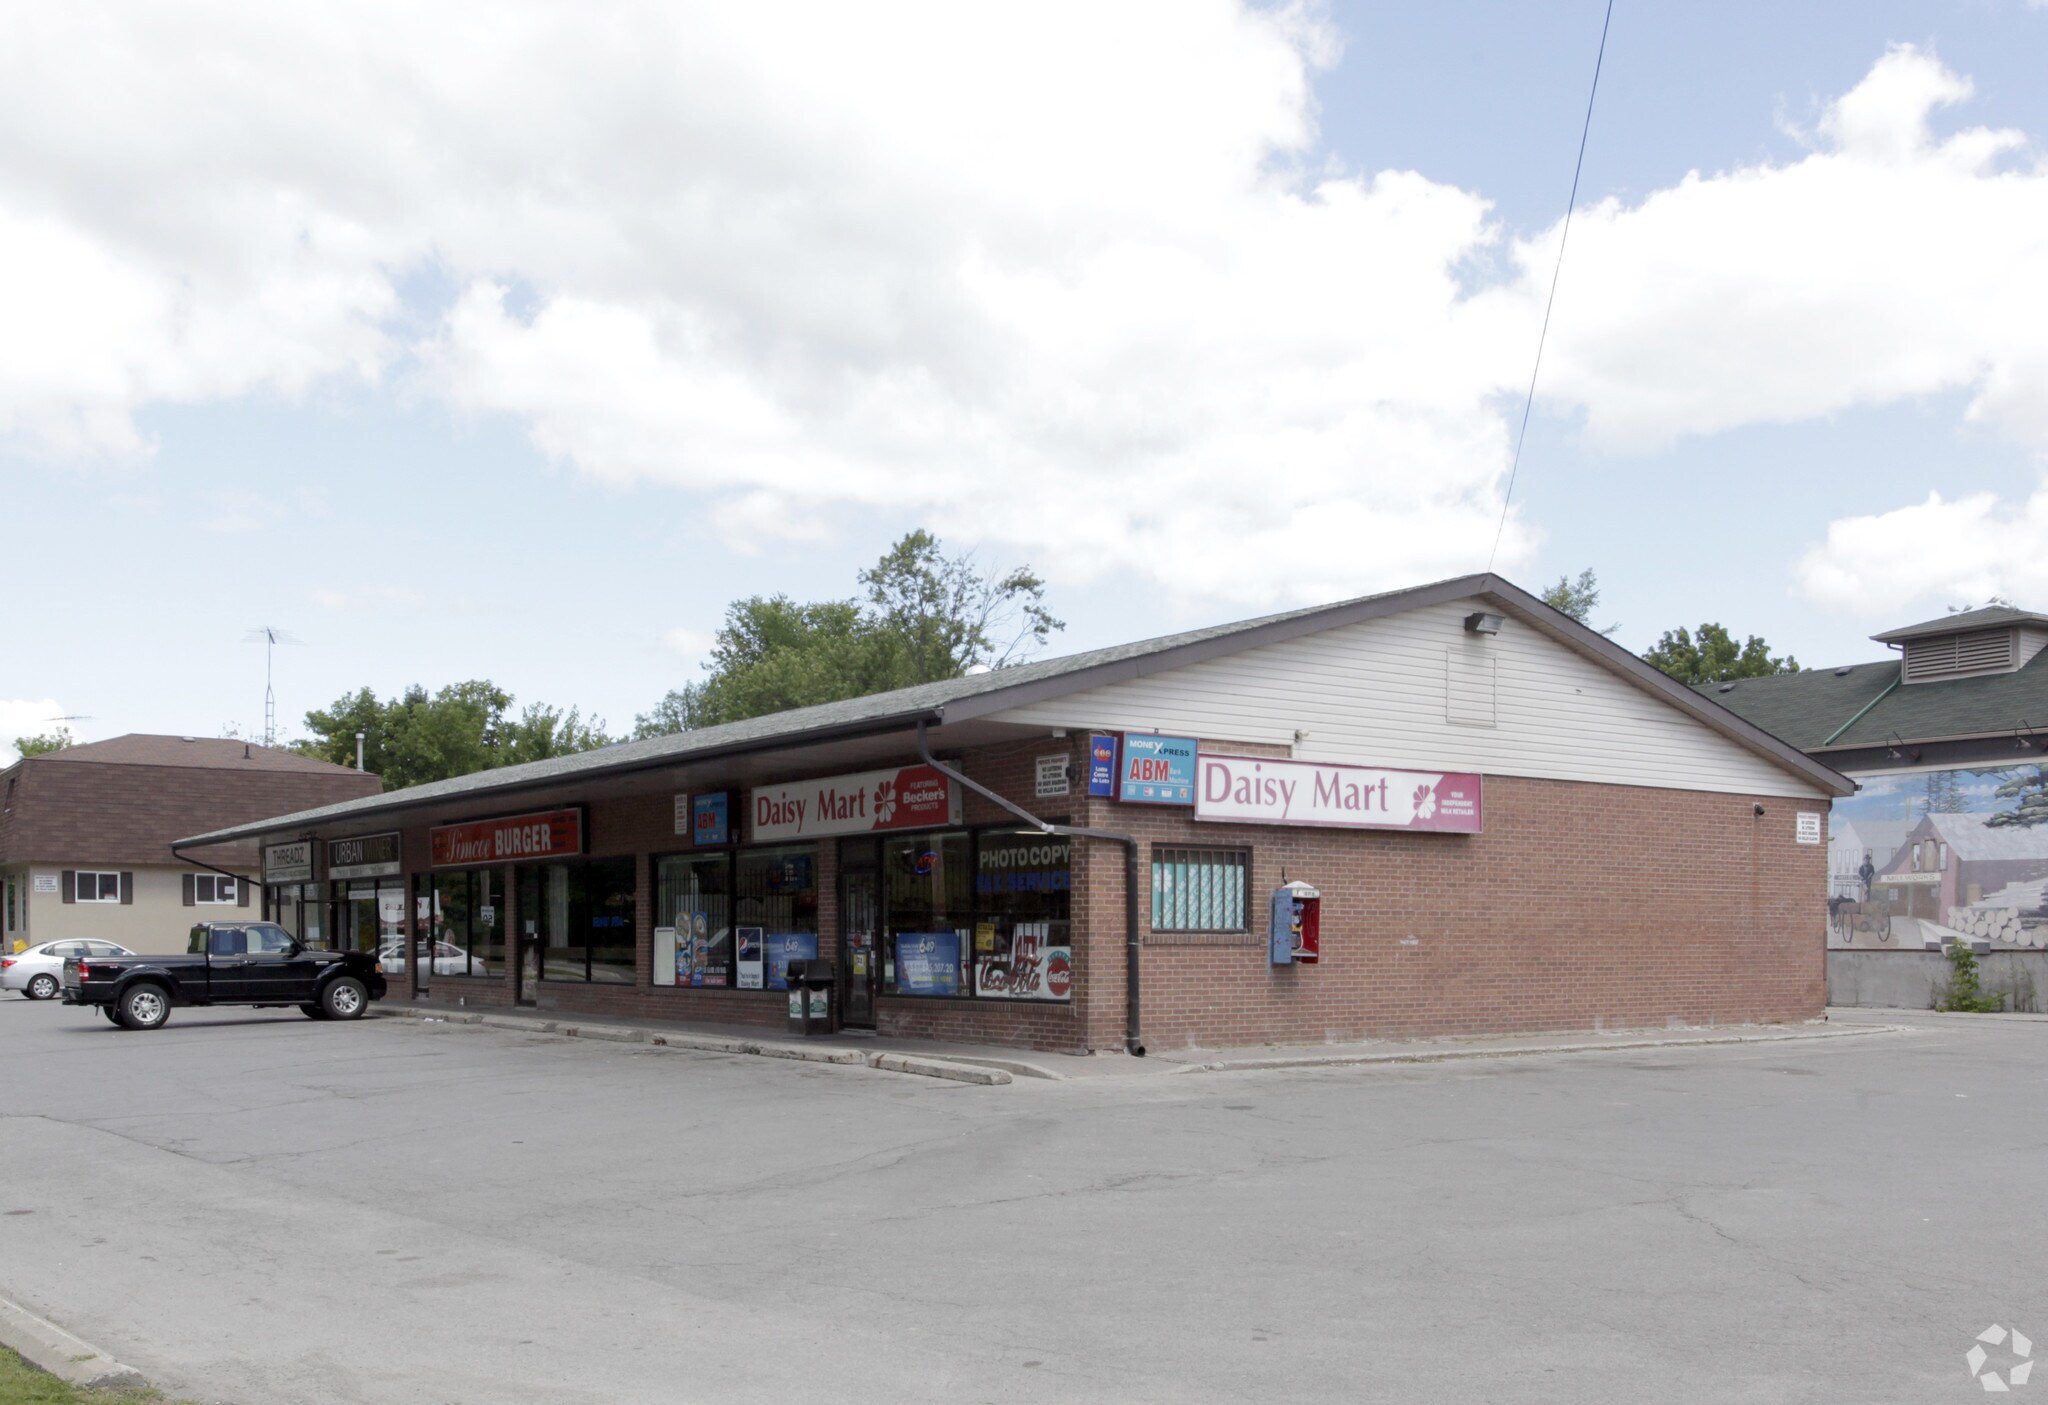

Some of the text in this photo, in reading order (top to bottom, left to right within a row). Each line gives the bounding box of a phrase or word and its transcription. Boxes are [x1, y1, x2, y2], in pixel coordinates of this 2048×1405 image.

[1129, 757, 1169, 782] ABM
[910, 779, 939, 789] FEATURING
[1205, 762, 1389, 818] Daisy Mart
[903, 788, 945, 804] Becker's
[911, 802, 939, 811] PRODUCTS
[757, 786, 866, 833] Daisy Mart
[698, 812, 716, 830] ABM
[335, 837, 391, 864] URBAN MINER
[446, 829, 491, 862] Simcoe
[495, 824, 551, 855] BURGER
[273, 847, 304, 866] THREADZ
